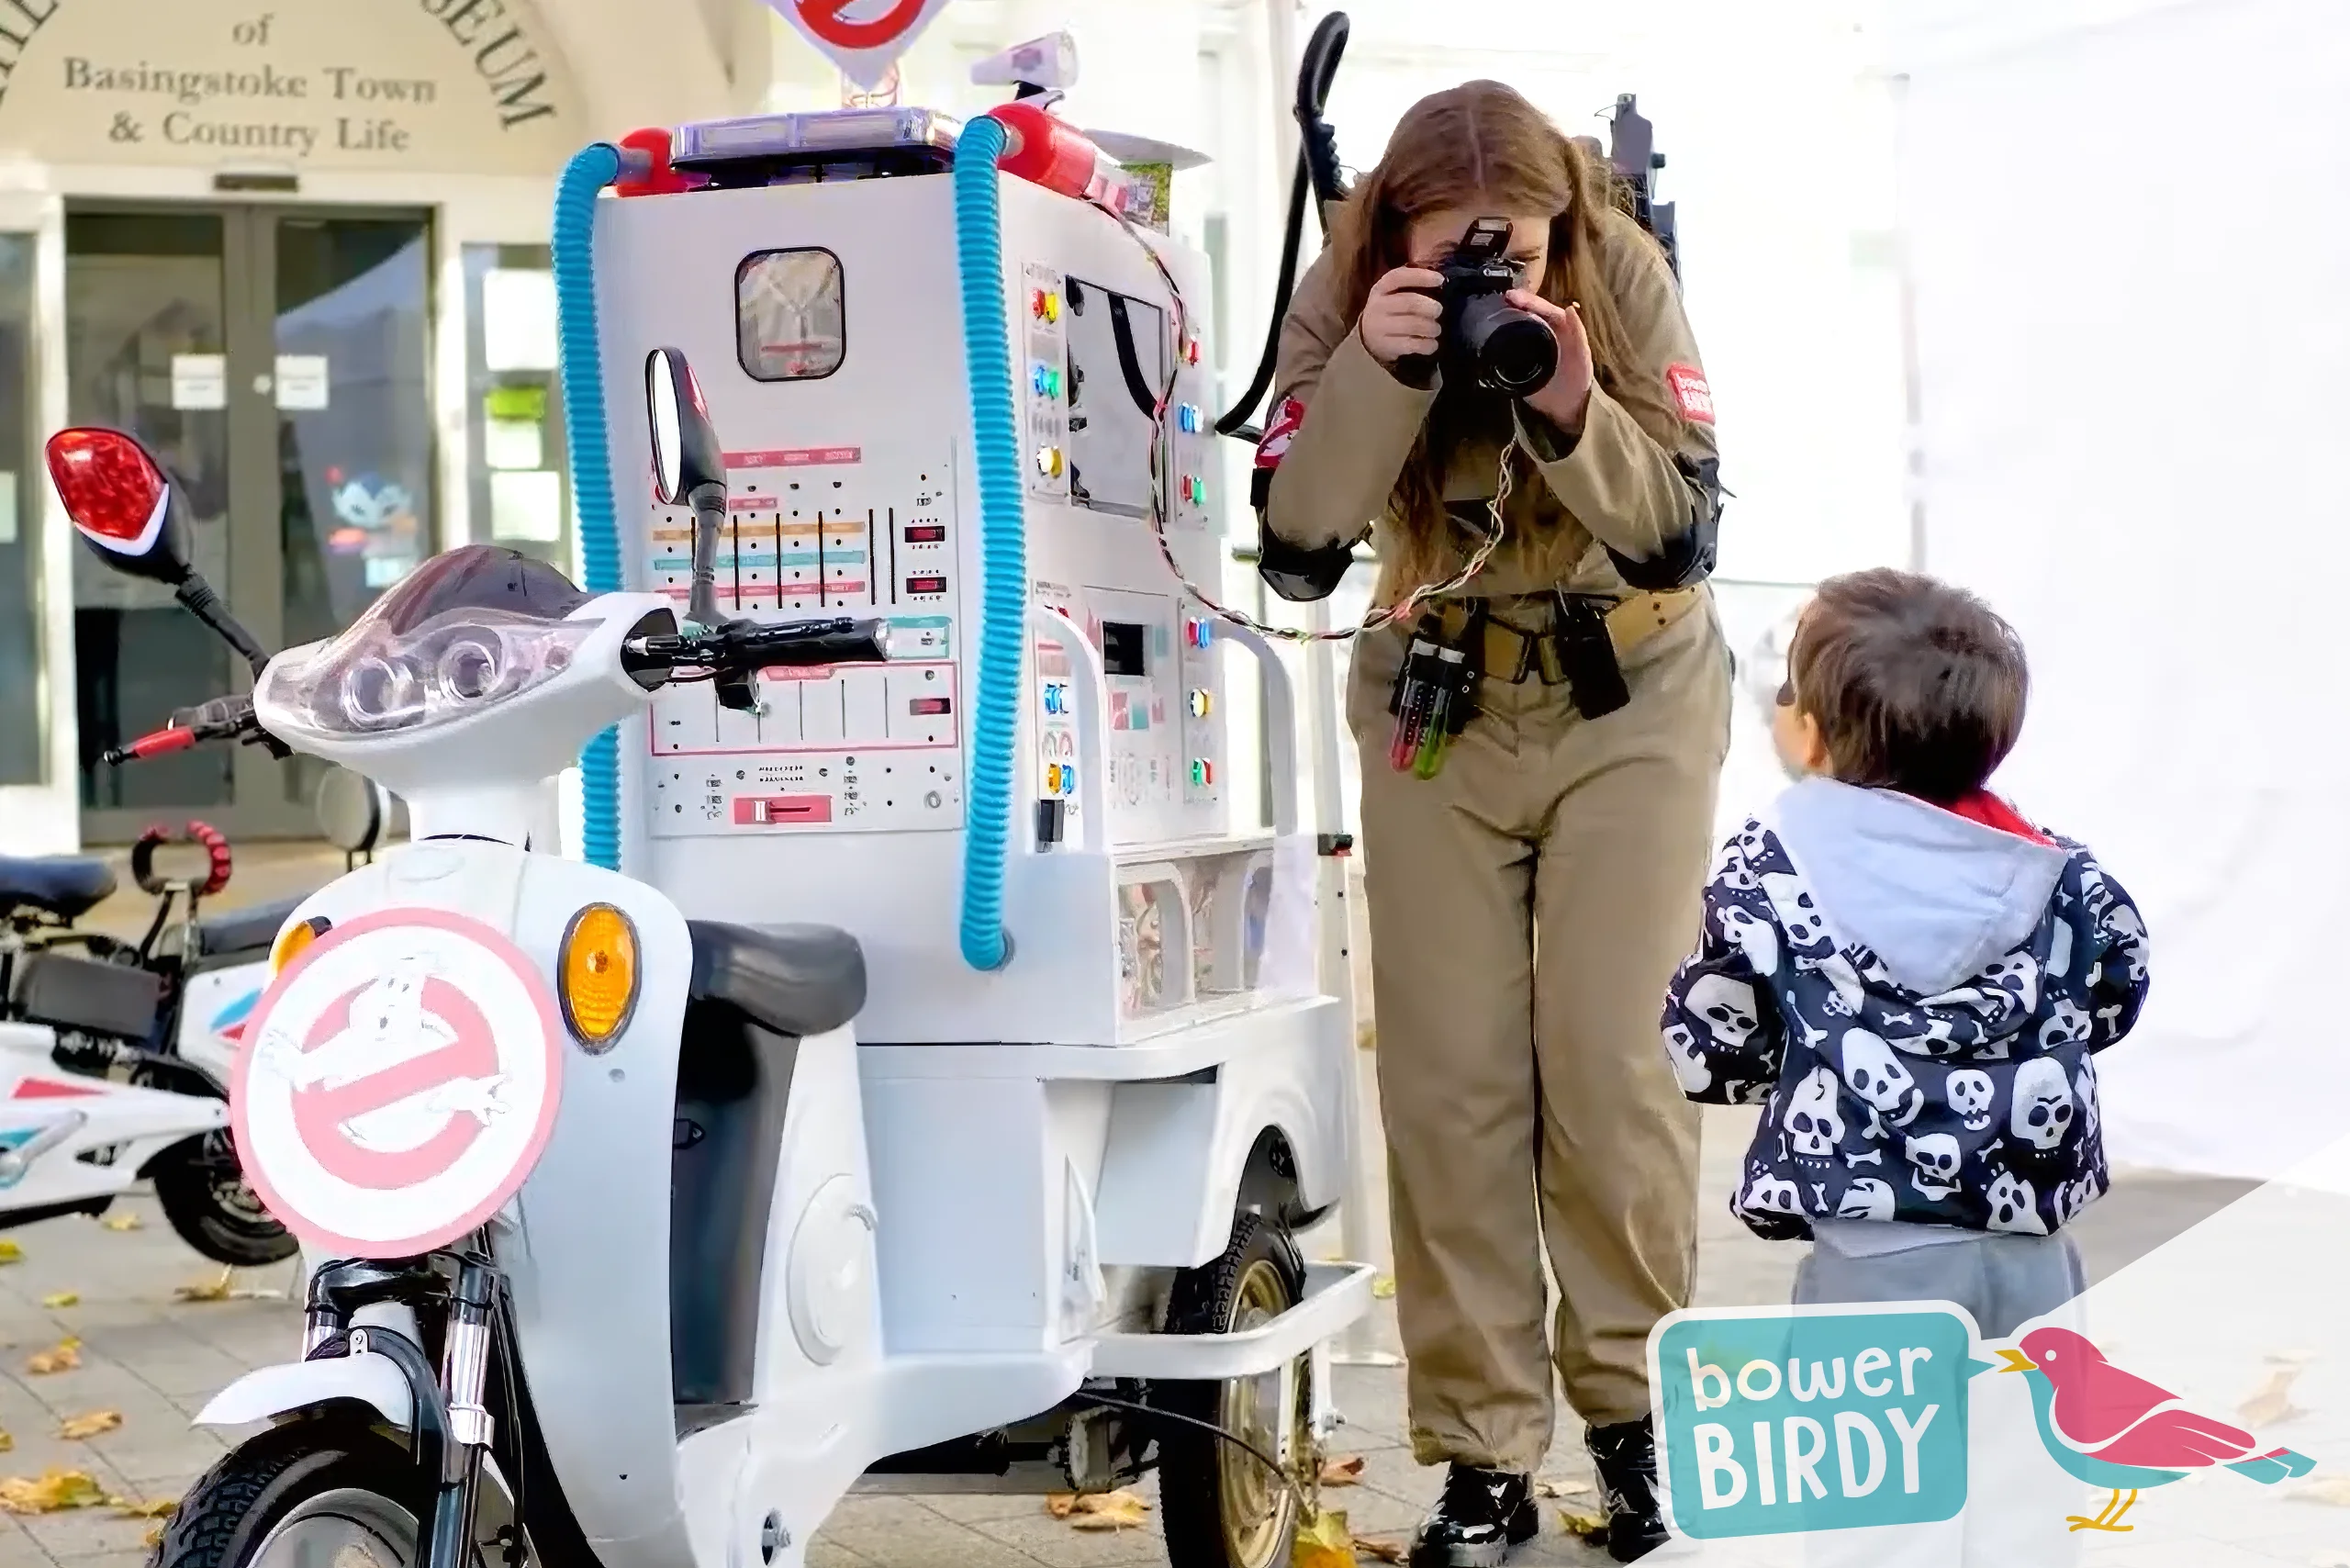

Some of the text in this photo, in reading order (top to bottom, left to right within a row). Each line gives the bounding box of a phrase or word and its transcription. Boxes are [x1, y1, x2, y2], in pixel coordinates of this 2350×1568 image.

[232, 13, 274, 46] of
[63, 56, 438, 104] Basingstoke Town
[108, 111, 411, 158] & Country Life
